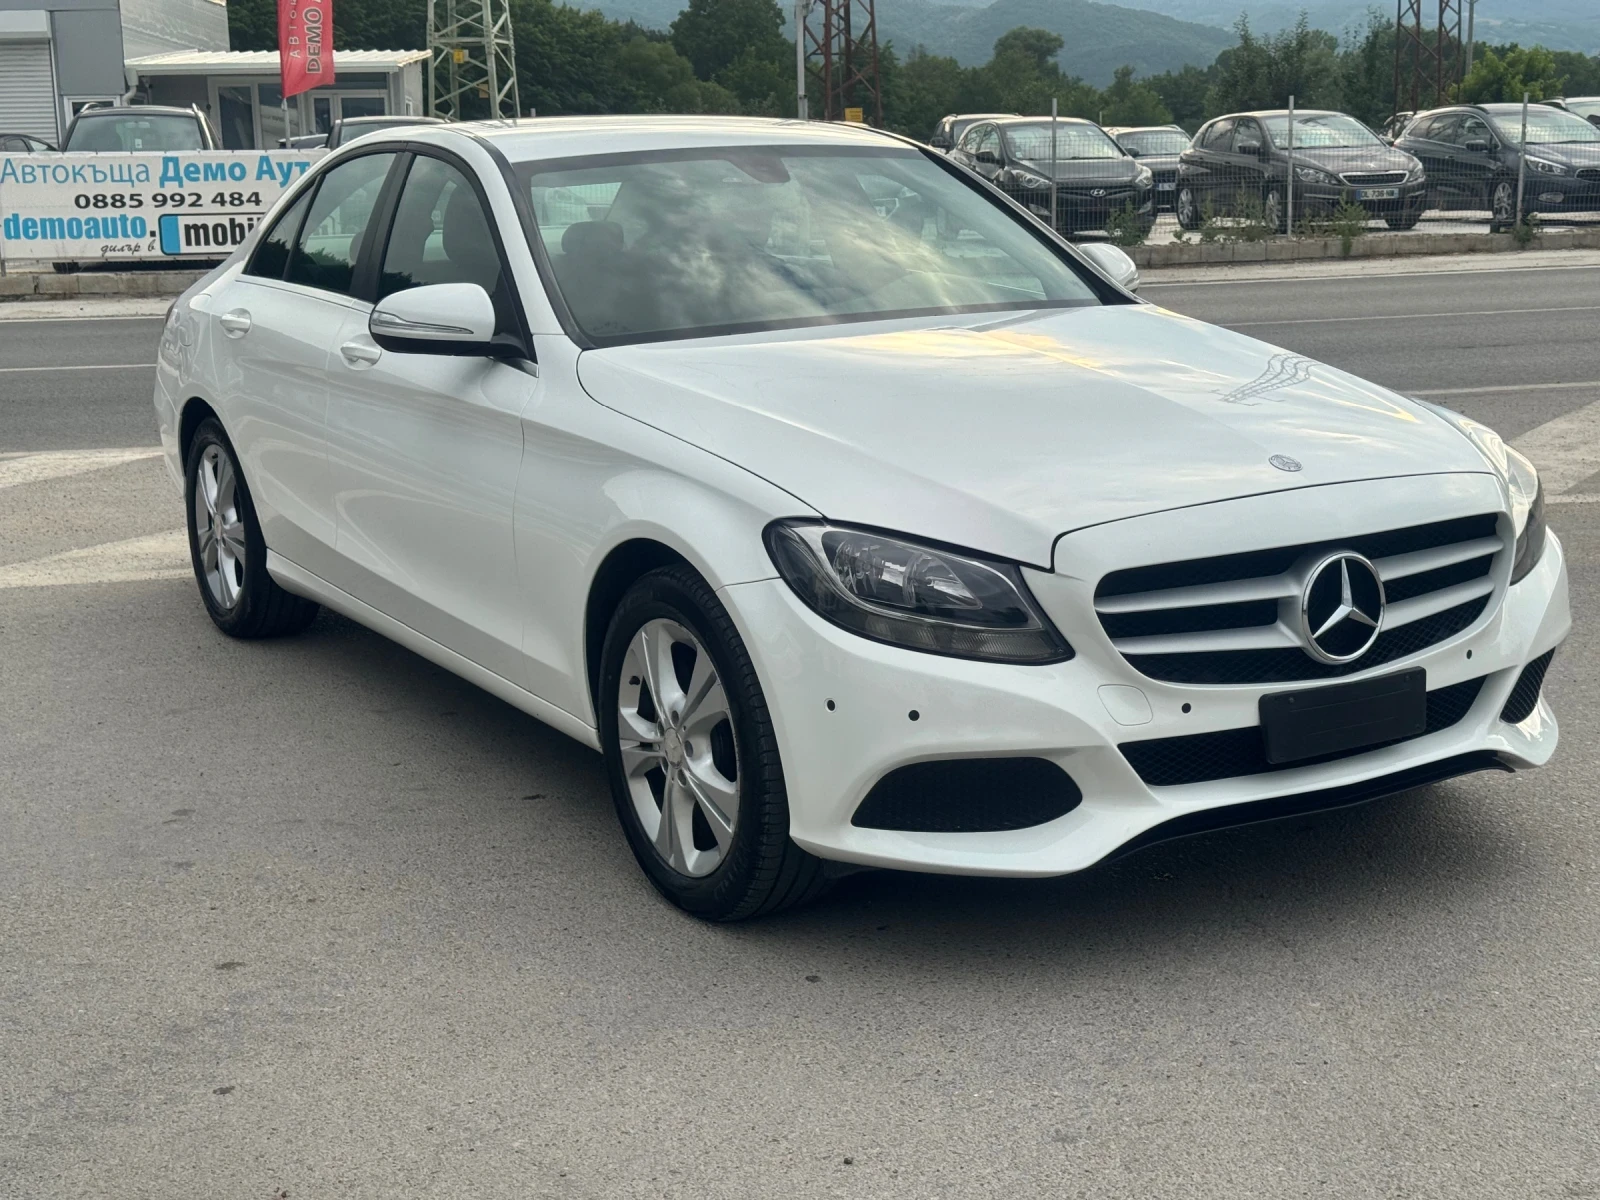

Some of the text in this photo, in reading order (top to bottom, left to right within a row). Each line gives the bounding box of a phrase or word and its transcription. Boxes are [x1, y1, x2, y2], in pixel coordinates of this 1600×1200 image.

[303, 7, 322, 73] DEMO
[0, 157, 150, 188] Автокъща
[159, 156, 246, 188] Демо
[74, 191, 262, 209] 0885 992 484
[184, 217, 264, 247] mobi
[100, 242, 141, 256] дилър
